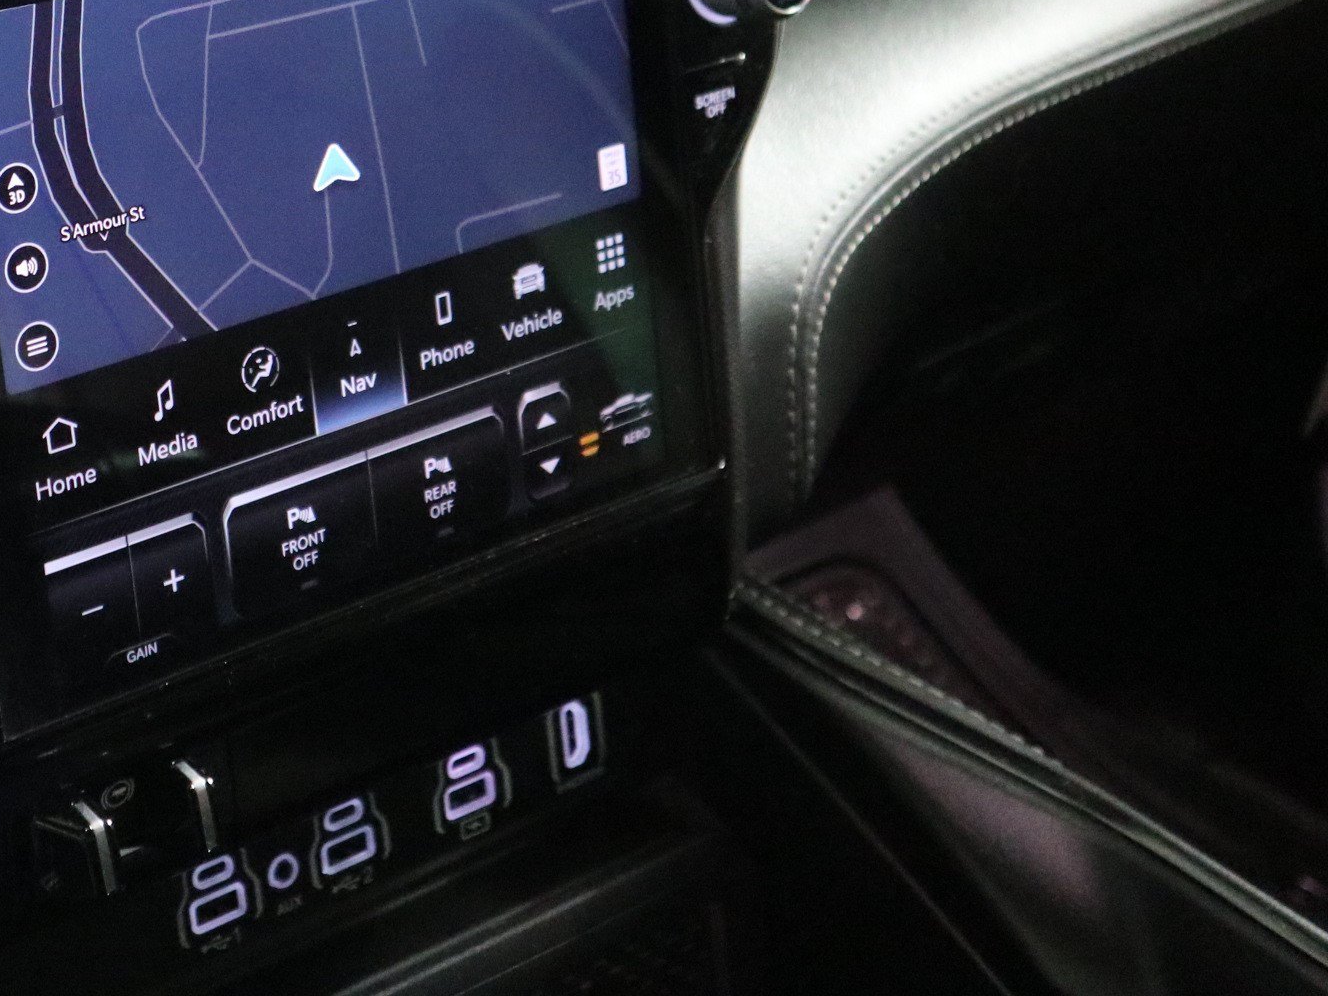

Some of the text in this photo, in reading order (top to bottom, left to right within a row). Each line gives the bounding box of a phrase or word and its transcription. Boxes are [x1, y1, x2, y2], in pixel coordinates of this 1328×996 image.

[8, 189, 26, 206] 3D
[60, 205, 146, 242] S Armour St
[592, 284, 635, 312] Apps
[500, 307, 563, 342] Vehicle
[419, 338, 476, 371] Phone
[340, 370, 378, 398] Nav
[226, 394, 304, 436] Comfort
[137, 431, 198, 467] Media
[621, 425, 652, 448] AERO
[35, 466, 98, 502] Home
[423, 480, 457, 504] REAR
[429, 499, 455, 520] OFF
[280, 527, 327, 558] FRONT
[292, 550, 320, 572] OFF
[126, 641, 159, 665] GAIN
